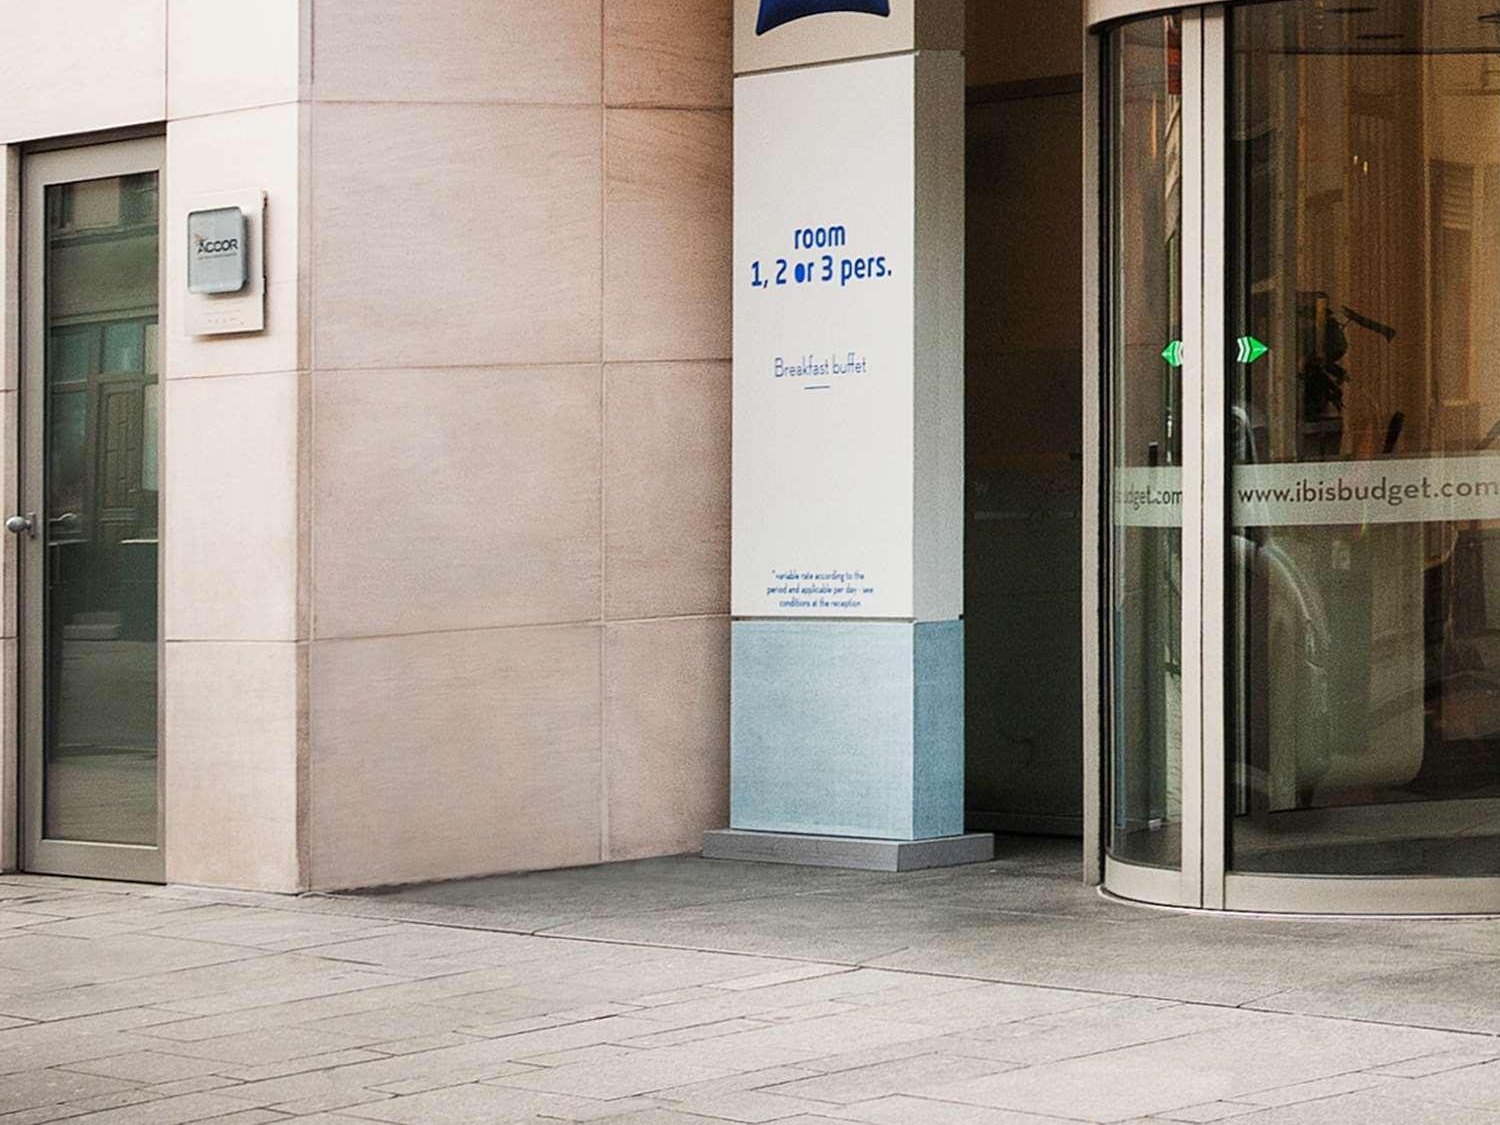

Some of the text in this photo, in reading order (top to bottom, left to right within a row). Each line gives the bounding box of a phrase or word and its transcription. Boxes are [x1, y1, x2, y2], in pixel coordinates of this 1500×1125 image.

[197, 238, 238, 253] ACCOR
[794, 225, 846, 249] room
[751, 255, 892, 288] 1, 2 or 3 pers.
[774, 351, 866, 378] Breakfast buffet
[1238, 476, 1499, 506] www.ibisbudget.com
[779, 596, 810, 608] conditions
